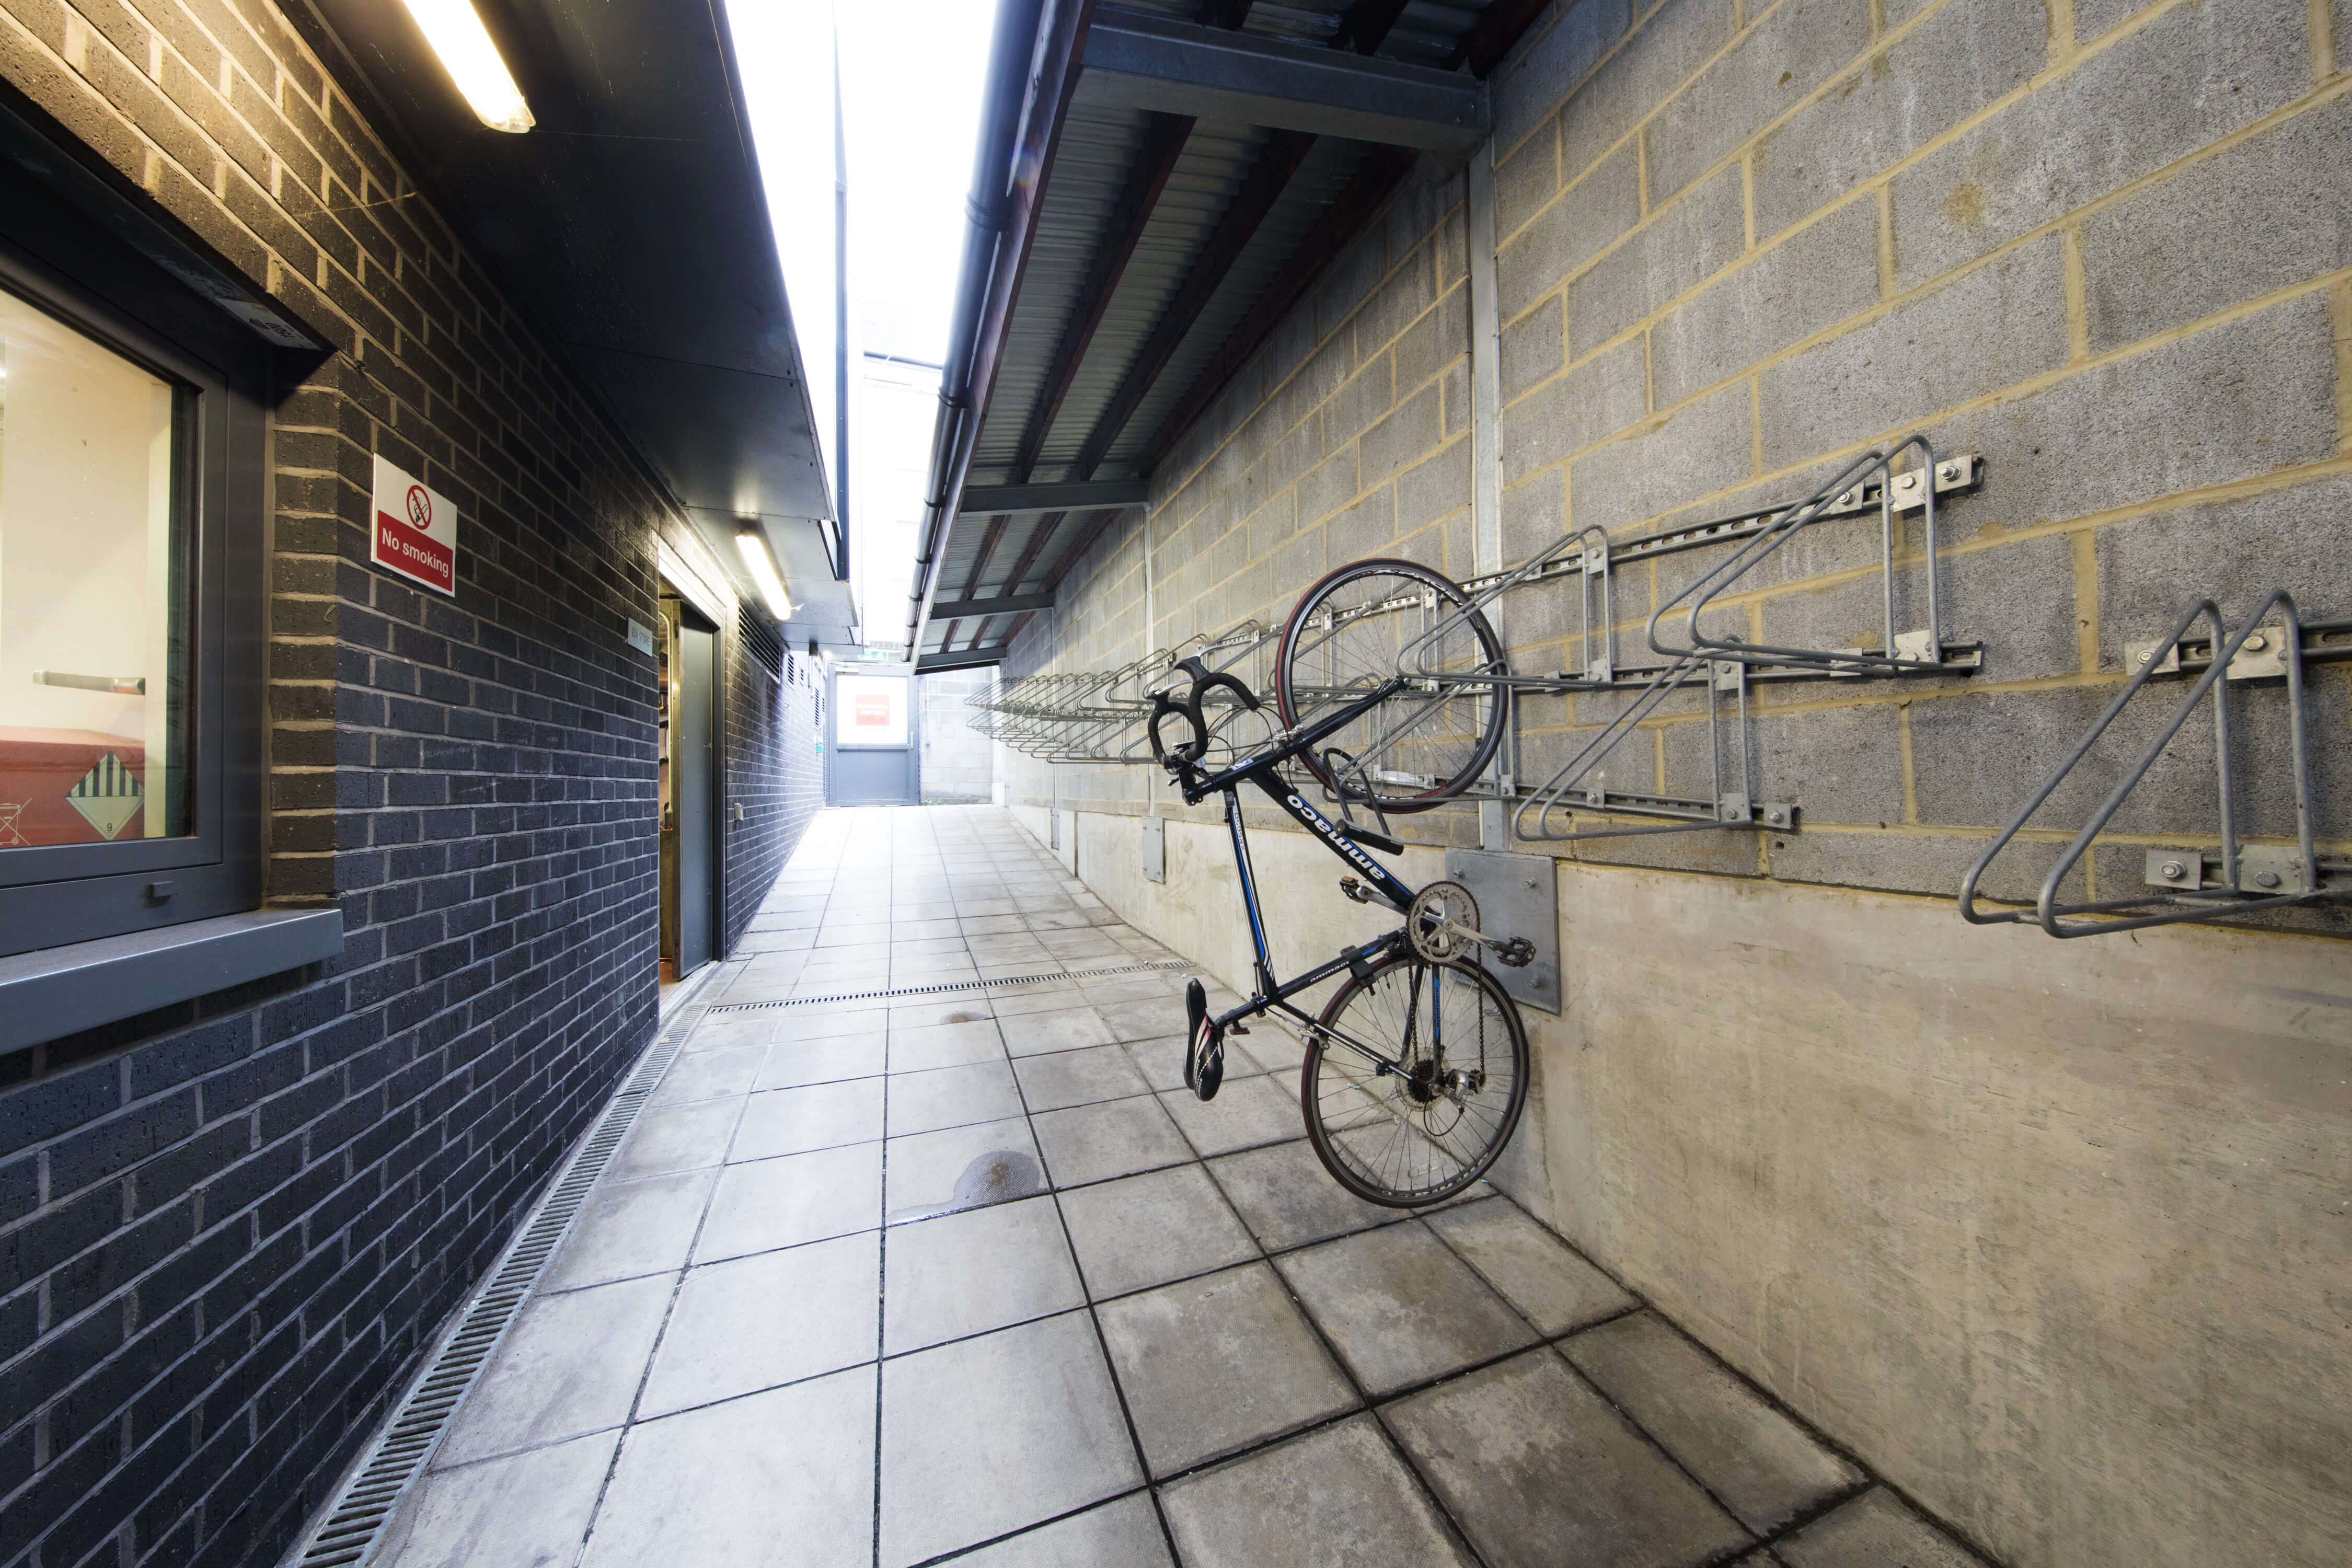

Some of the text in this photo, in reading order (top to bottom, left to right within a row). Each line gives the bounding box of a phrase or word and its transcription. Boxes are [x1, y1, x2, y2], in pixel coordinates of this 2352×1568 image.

[382, 527, 448, 578] No smoking
[639, 632, 650, 647] STORE
[107, 823, 112, 832] 9
[1287, 794, 1385, 880] ammaco
